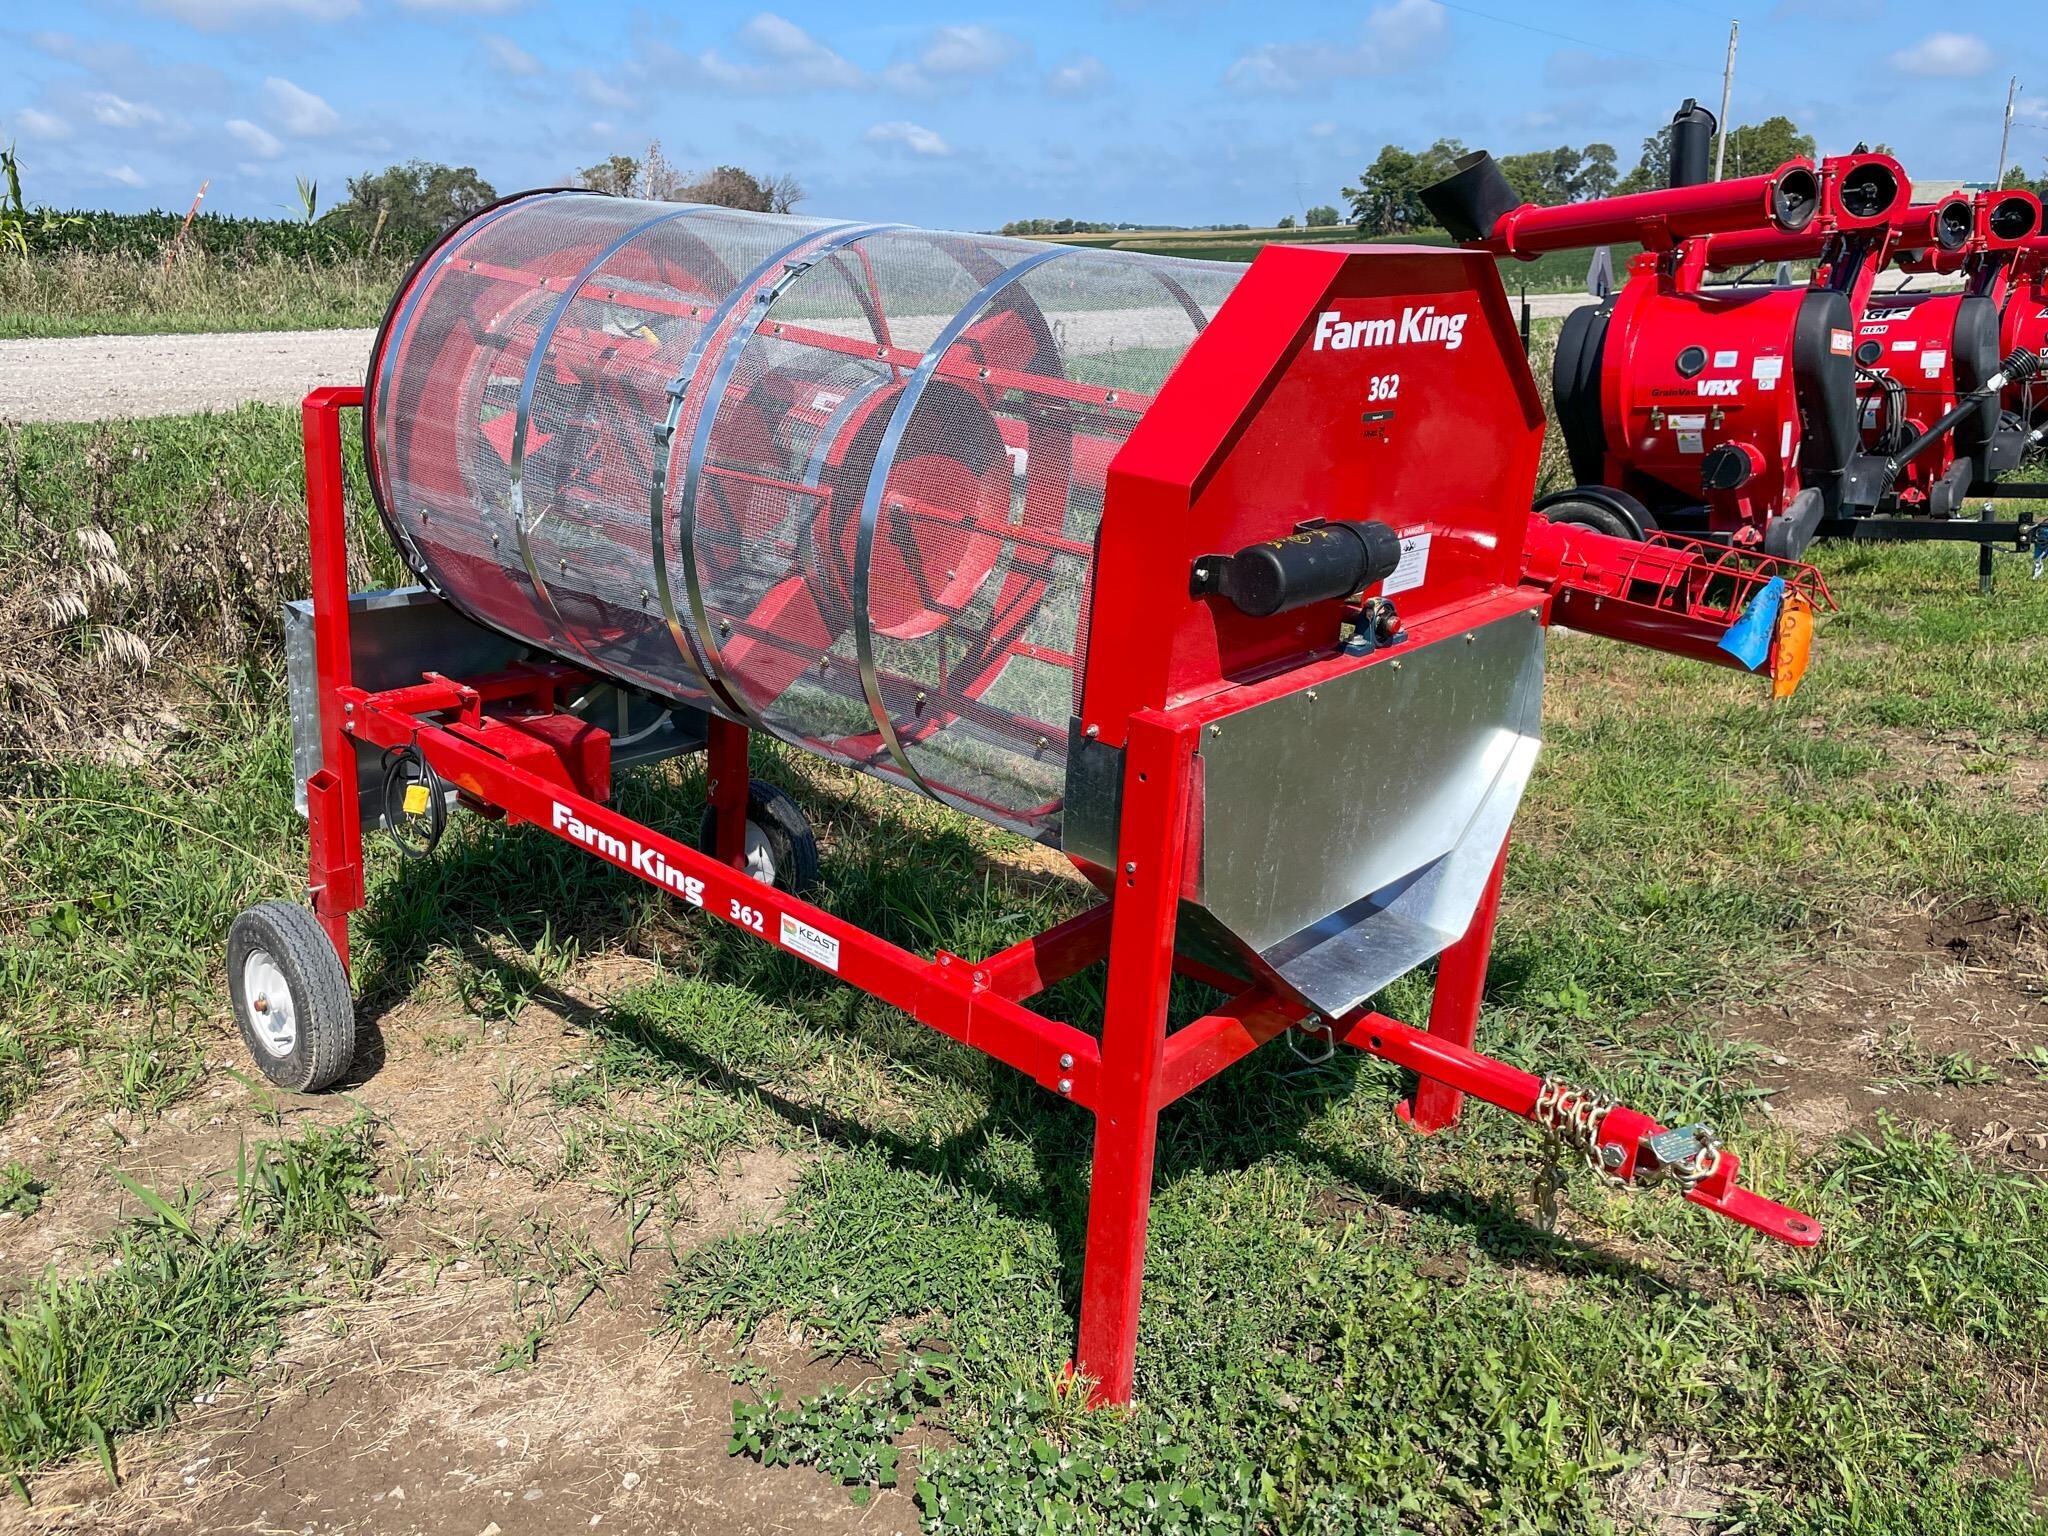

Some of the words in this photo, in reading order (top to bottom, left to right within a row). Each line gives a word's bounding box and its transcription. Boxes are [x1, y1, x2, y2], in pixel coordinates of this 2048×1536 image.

[1313, 311, 1396, 351] Farm
[1398, 306, 1468, 350] King
[1368, 374, 1400, 402] 362
[1697, 379, 1742, 396] VRX
[1404, 524, 1425, 537] DANGER
[552, 800, 627, 862] Farm
[631, 840, 705, 908] King
[729, 898, 764, 933] 362
[799, 926, 838, 952] KEAST
